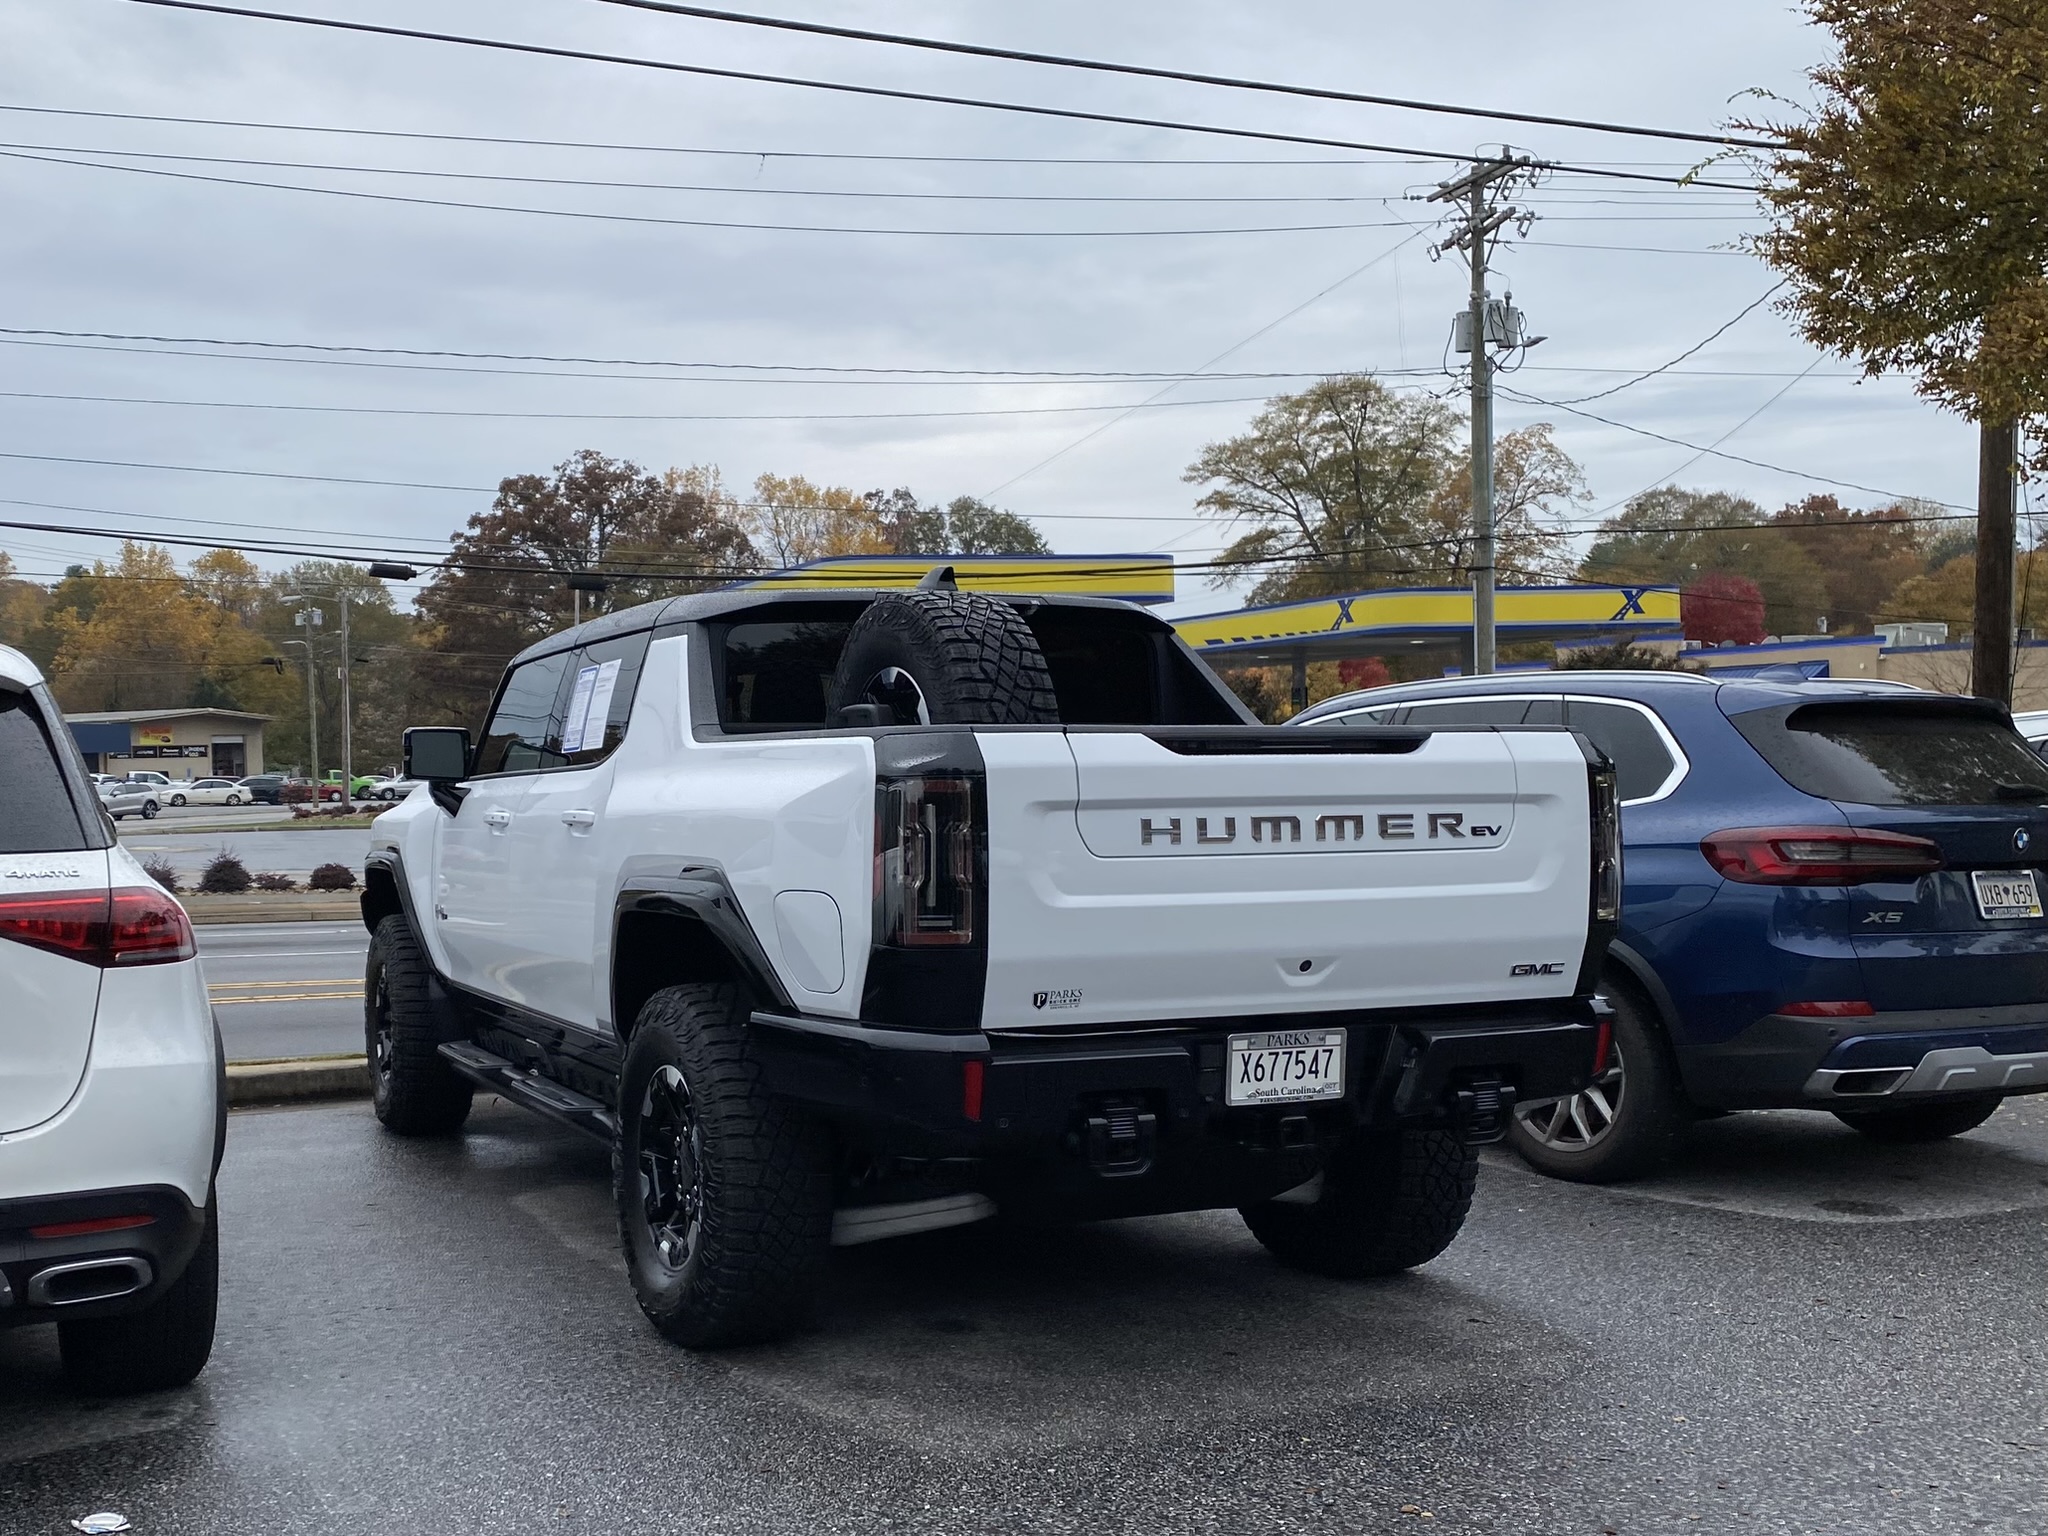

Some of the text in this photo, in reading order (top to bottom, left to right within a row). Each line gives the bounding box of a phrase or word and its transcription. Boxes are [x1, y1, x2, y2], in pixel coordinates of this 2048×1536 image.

[1139, 812, 1503, 846] HUMMER EV
[5, 868, 80, 879] 4MATIC
[1980, 884, 2033, 905] UXB 659
[1862, 911, 1904, 924] X5
[1509, 963, 1566, 978] GMC
[1049, 988, 1083, 999] PARKS
[1266, 1032, 1310, 1047] PARKS
[1240, 1048, 1334, 1084] X677547
[1255, 1085, 1317, 1098] South Carolina
